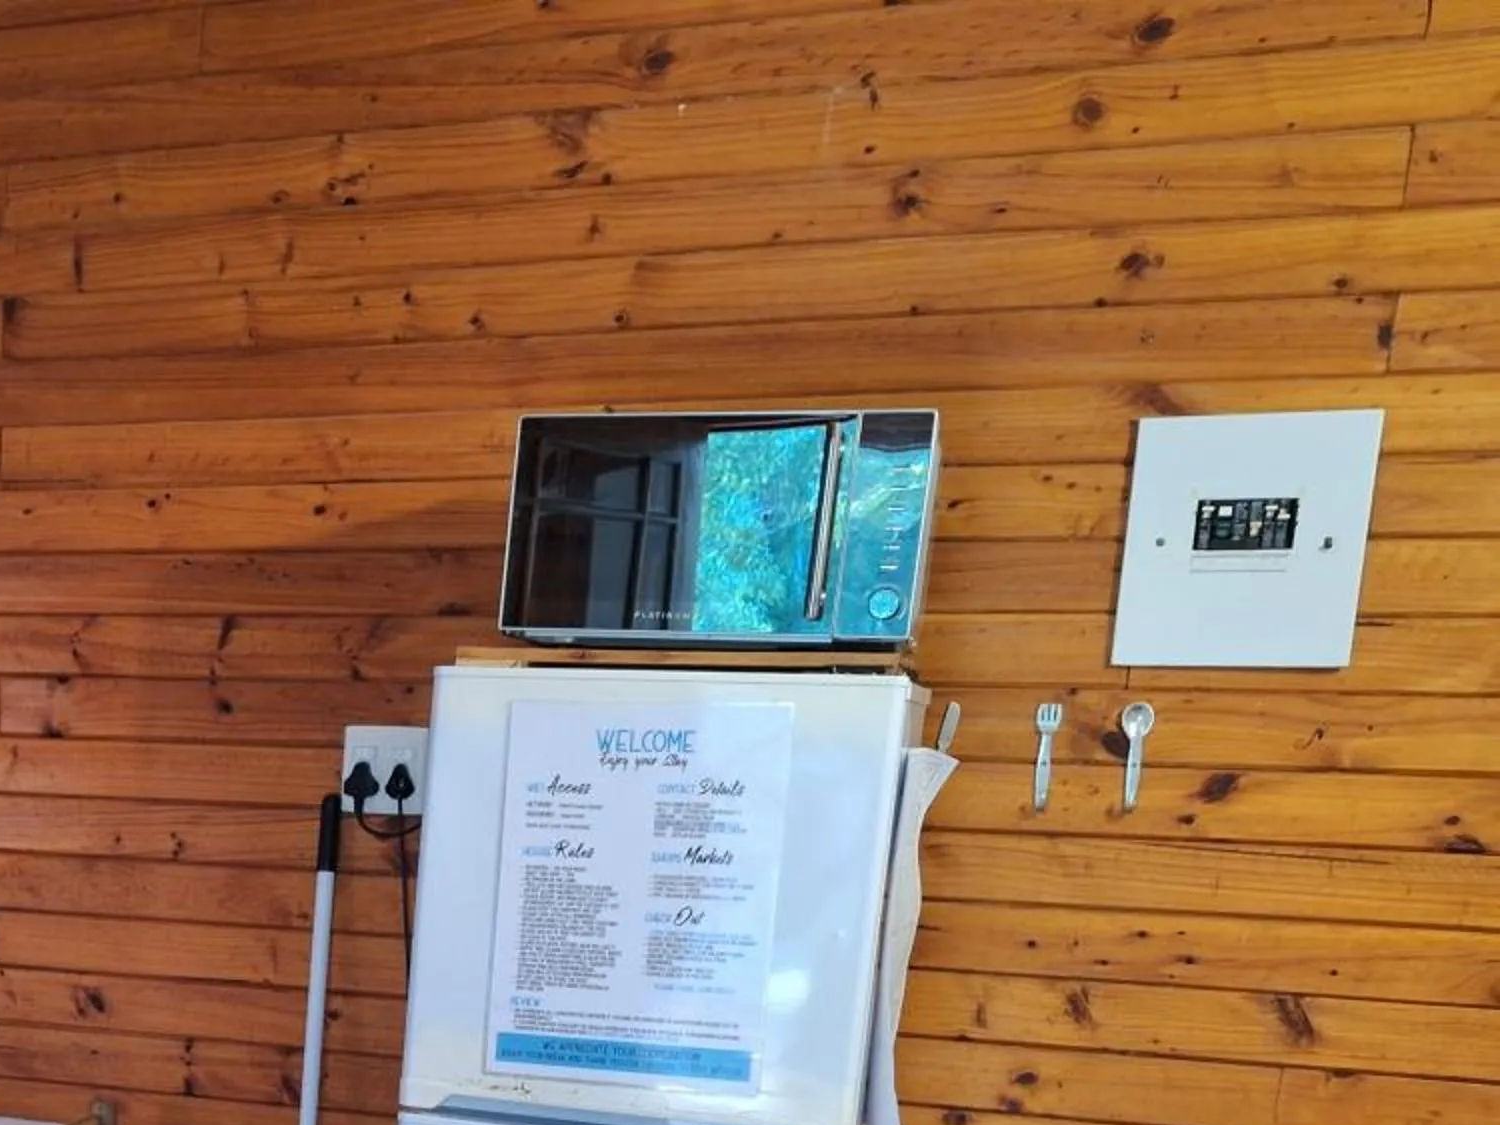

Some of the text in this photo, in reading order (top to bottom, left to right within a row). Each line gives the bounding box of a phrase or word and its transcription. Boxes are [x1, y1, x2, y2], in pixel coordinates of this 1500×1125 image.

[596, 728, 696, 753] WELCOME
[599, 752, 688, 774] Enjoy your Stay
[547, 774, 592, 797] Access
[699, 777, 746, 798] Details
[554, 839, 596, 860] Rules
[683, 845, 735, 867] Markets
[673, 905, 706, 927] Out
